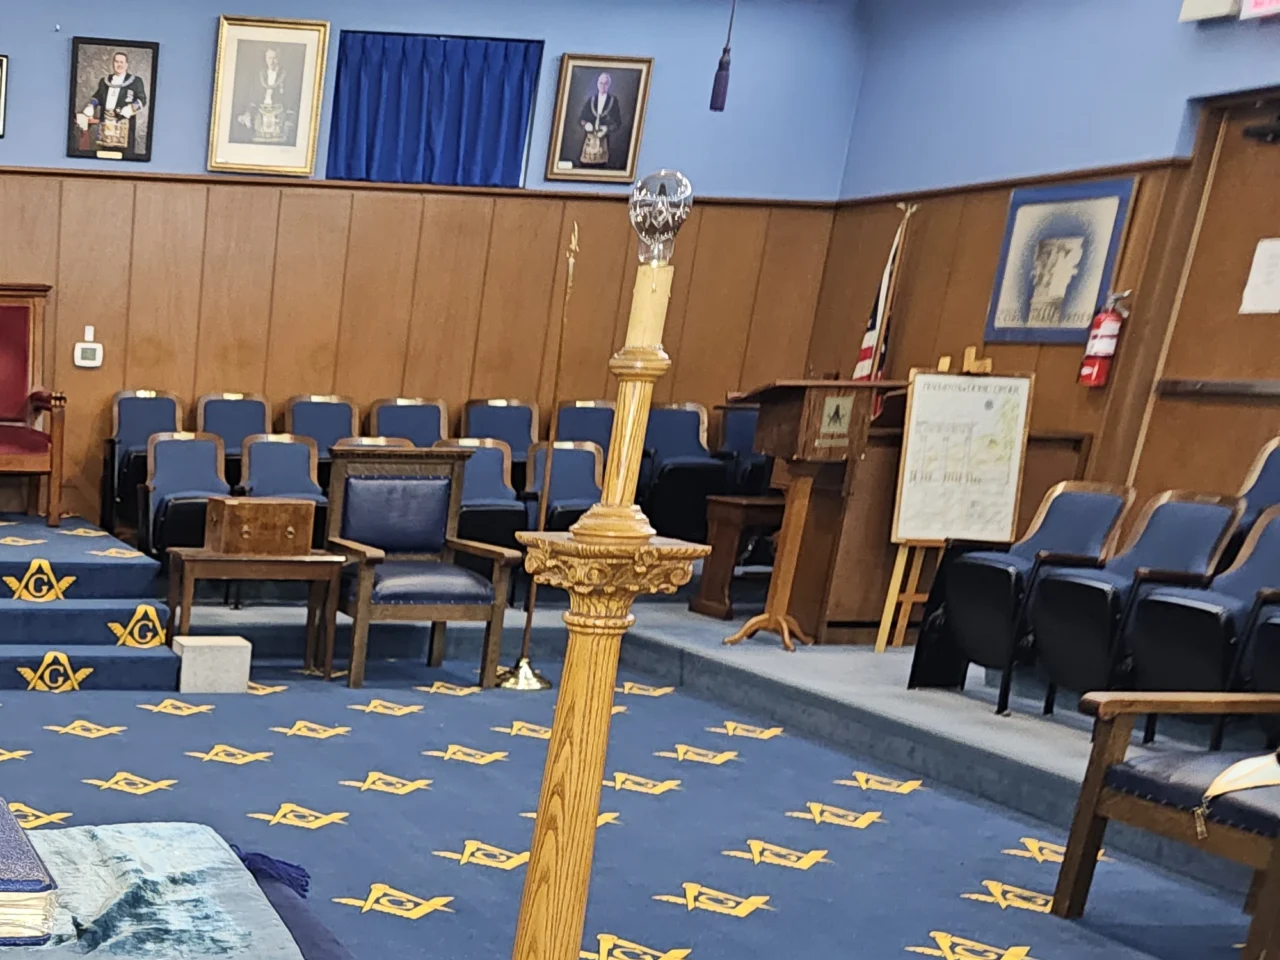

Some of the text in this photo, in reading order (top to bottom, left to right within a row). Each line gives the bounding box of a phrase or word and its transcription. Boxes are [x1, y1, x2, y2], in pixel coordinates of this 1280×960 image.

[28, 574, 49, 596] G
[133, 620, 153, 643] G
[44, 665, 64, 687] G
